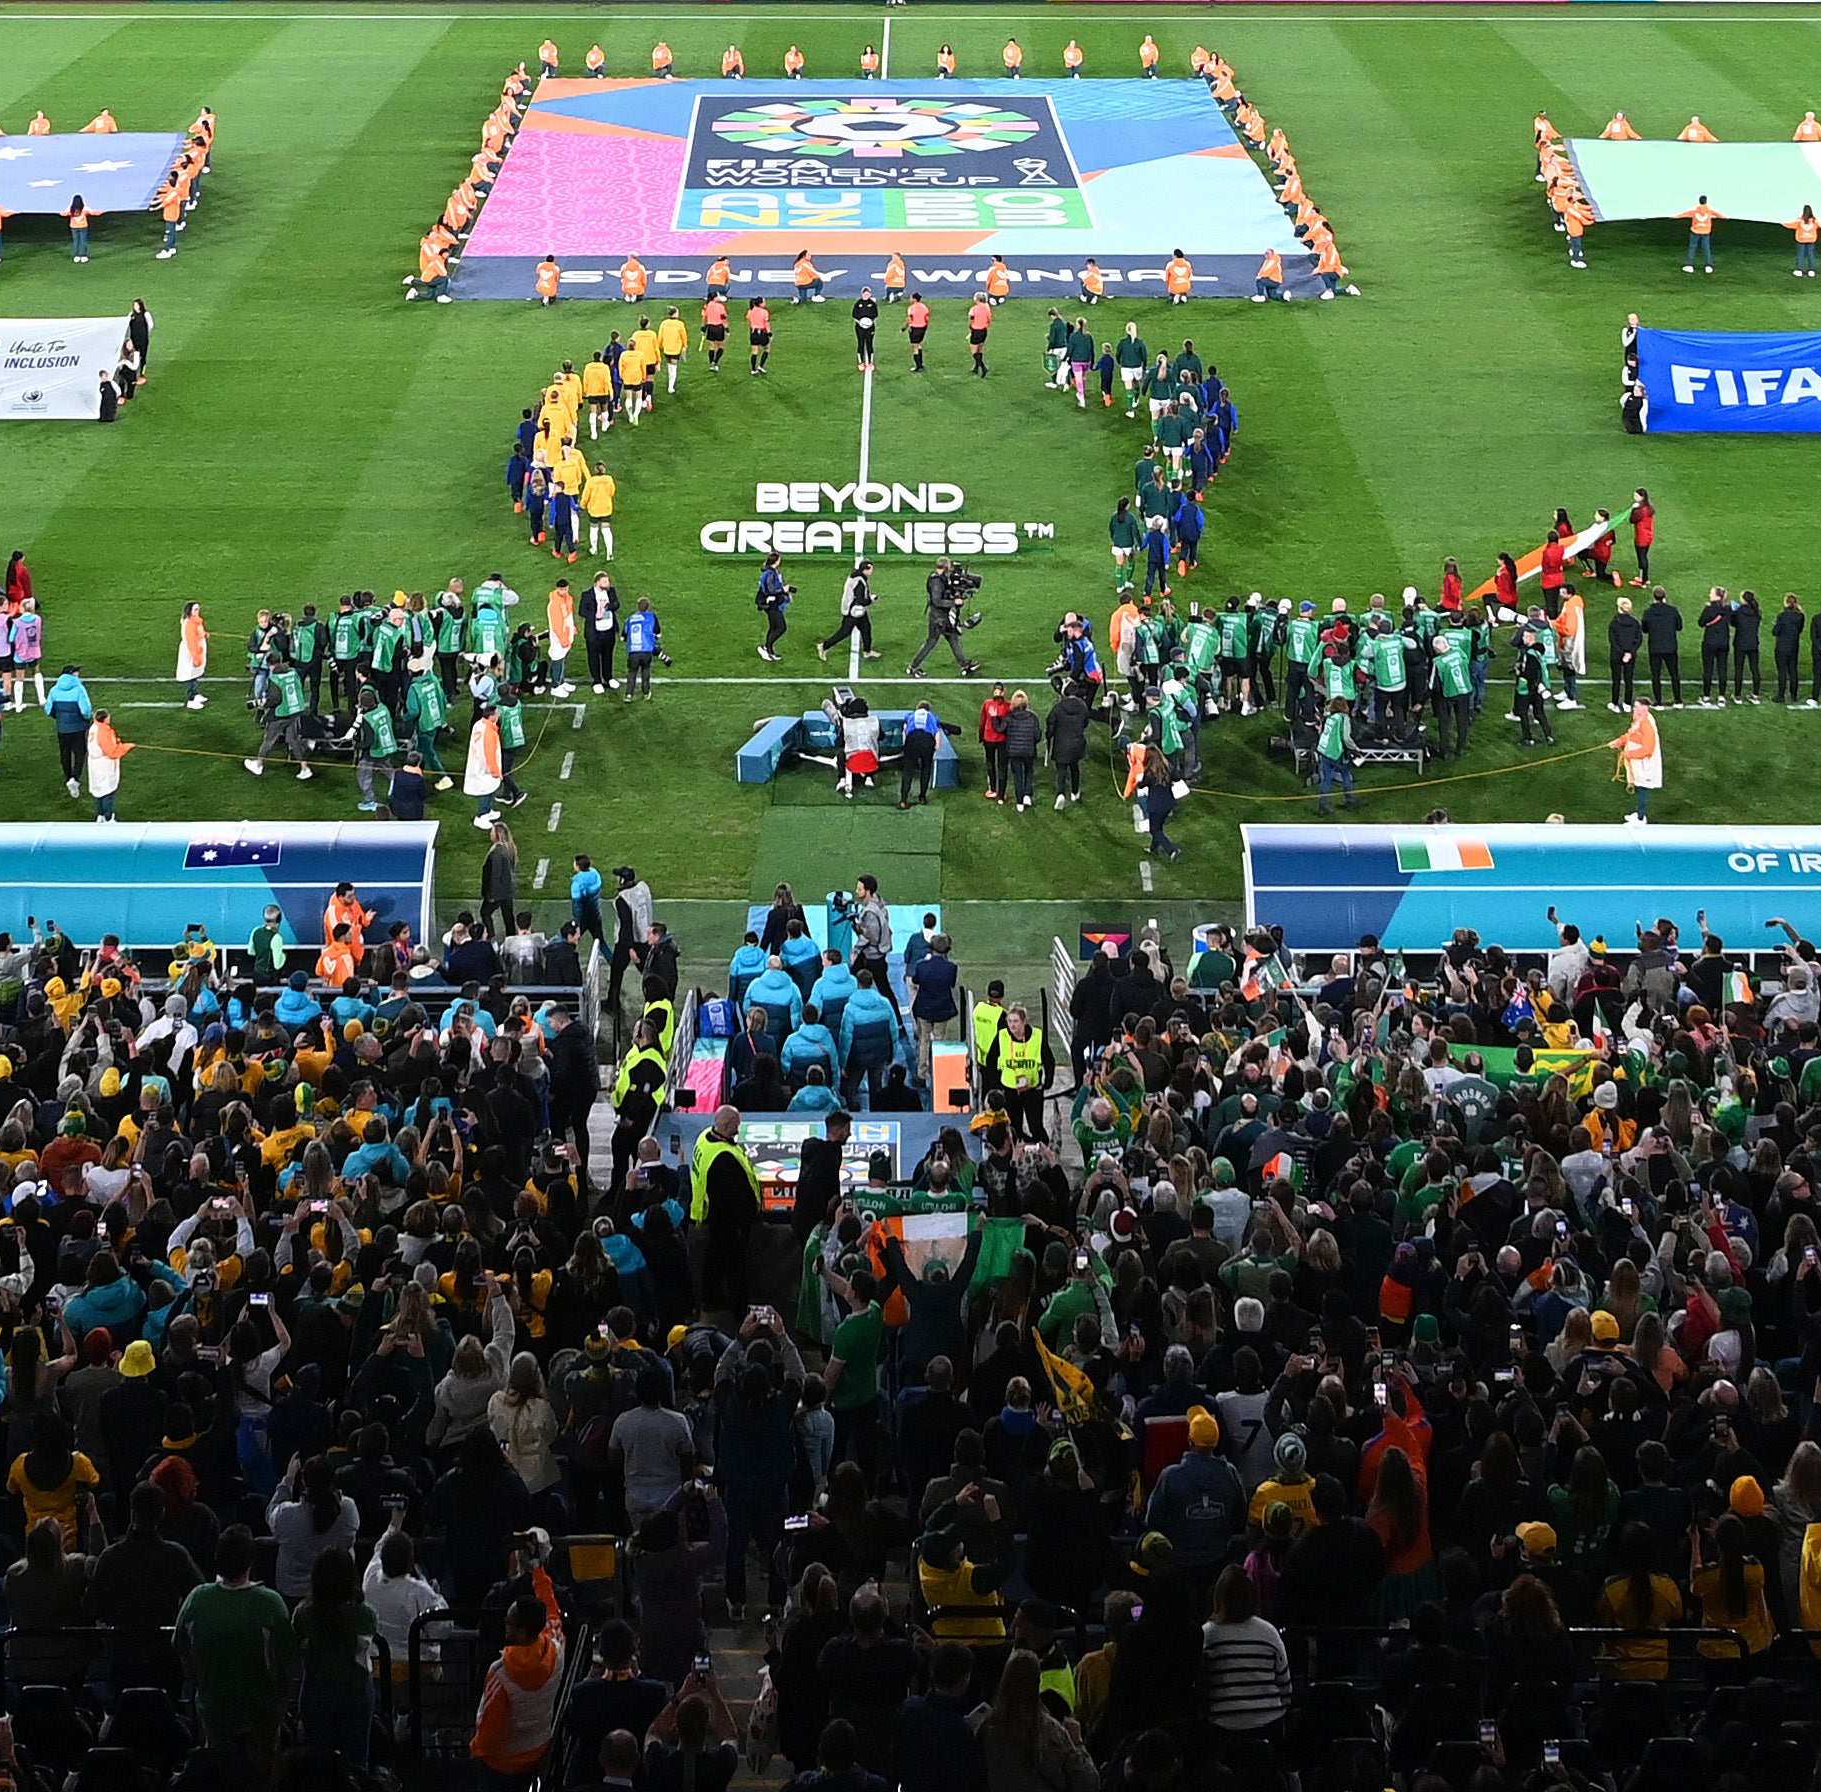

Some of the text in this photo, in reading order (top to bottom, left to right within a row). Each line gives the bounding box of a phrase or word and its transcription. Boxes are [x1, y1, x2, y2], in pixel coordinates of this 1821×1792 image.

[705, 158, 831, 168] FIFA
[705, 166, 949, 177] WOMEN'S
[703, 176, 1001, 186] WORLD CUP
[903, 191, 1066, 209] 20
[698, 208, 1070, 227] NZ 23
[47, 341, 68, 354] For
[3, 355, 81, 370] INCLUSION
[755, 481, 965, 514] BEYOND
[1728, 852, 1780, 874] OF
[1240, 1419, 1263, 1454] 7
